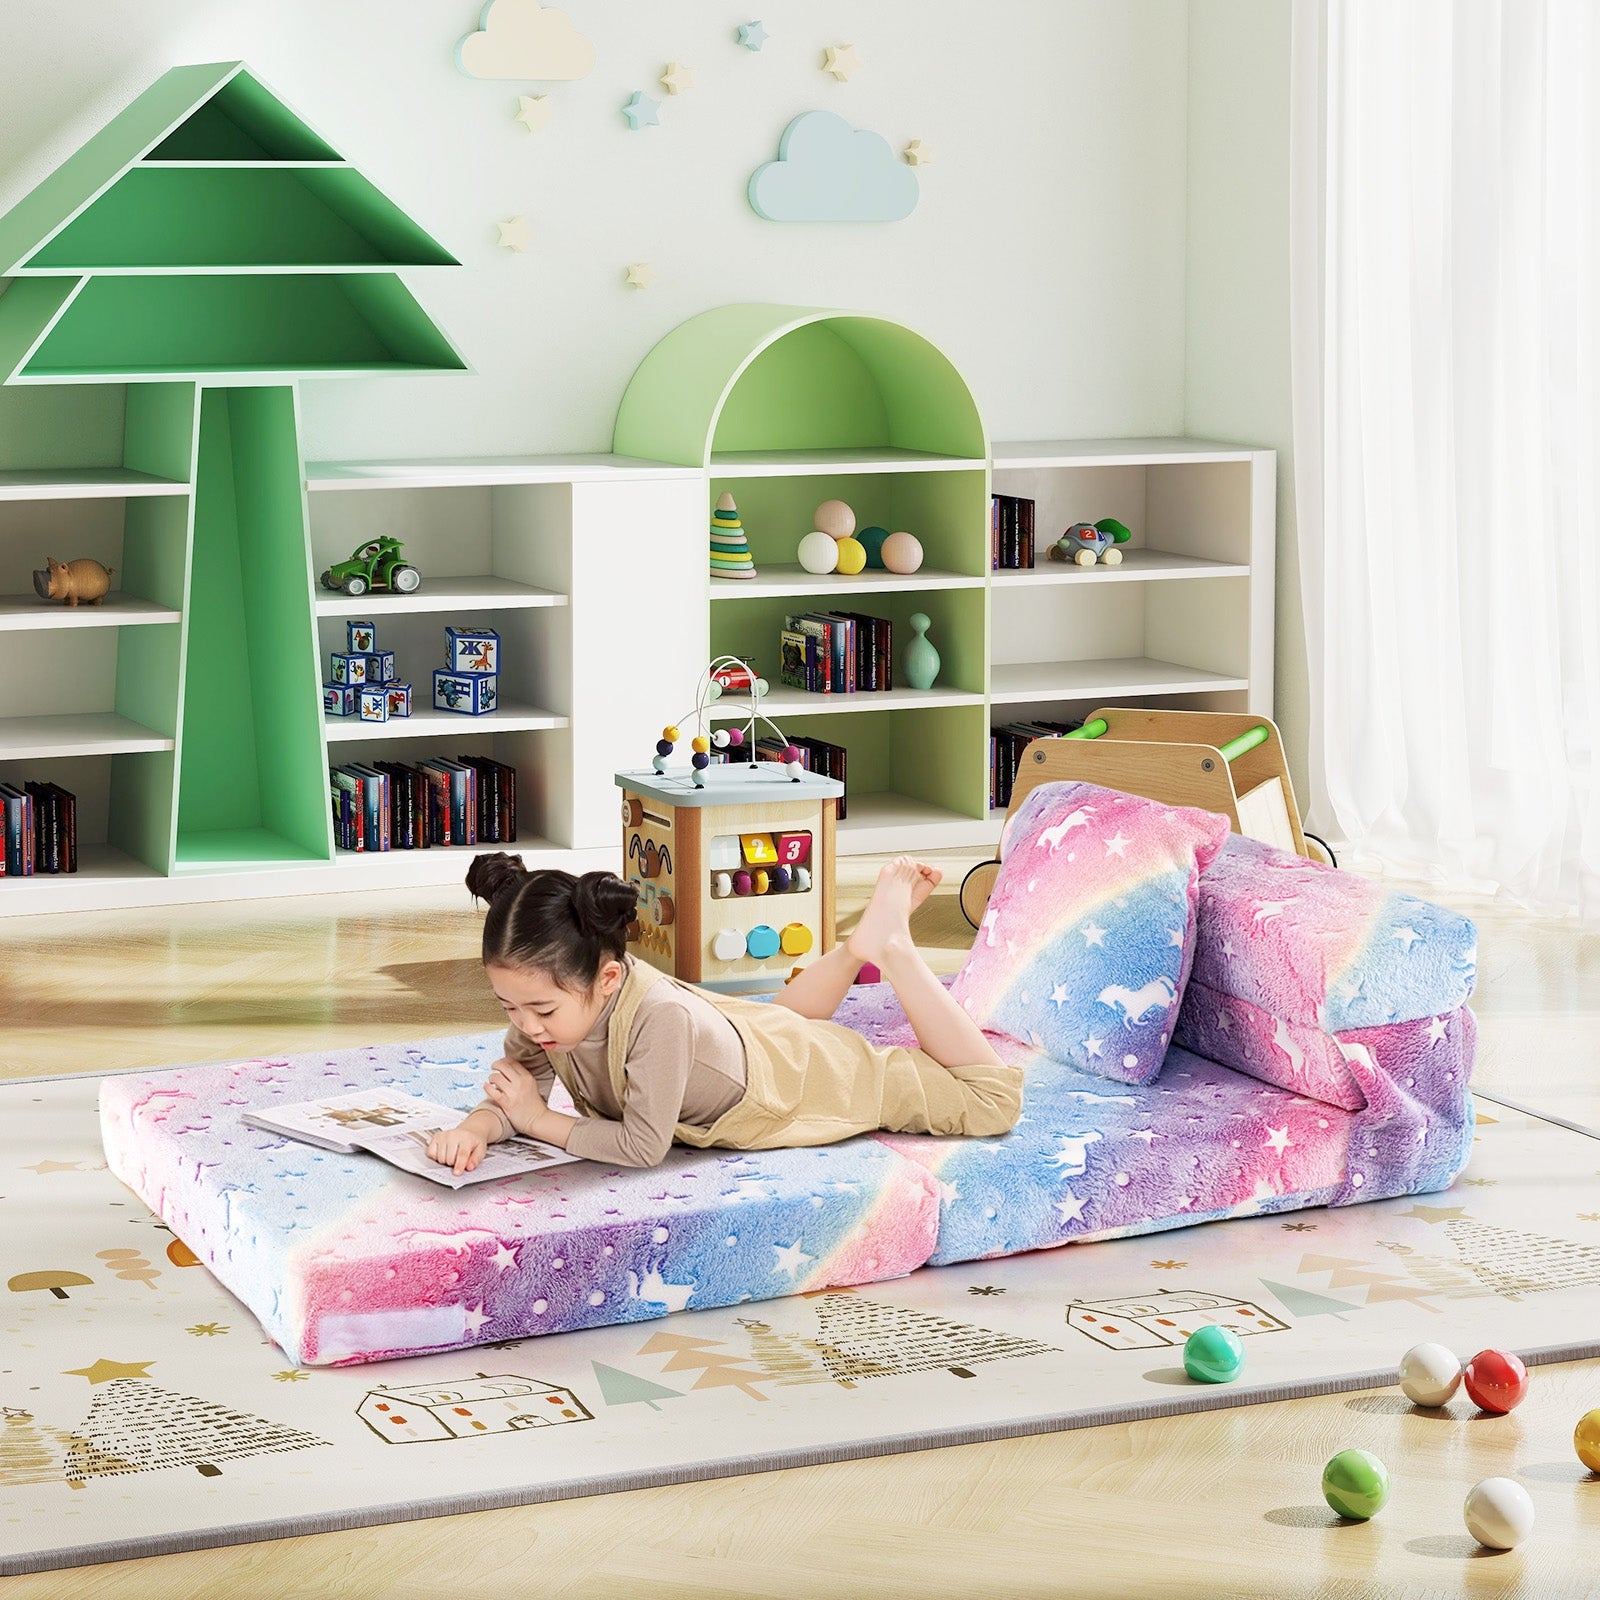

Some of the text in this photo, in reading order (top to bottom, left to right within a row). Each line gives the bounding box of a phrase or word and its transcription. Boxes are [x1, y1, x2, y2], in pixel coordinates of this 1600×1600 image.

[1084, 529, 1093, 538] 2
[458, 640, 483, 656] Ж
[722, 676, 727, 686] 1
[372, 696, 382, 712] Ж
[720, 840, 728, 864] 1
[751, 838, 767, 858] 2
[786, 840, 801, 860] 3
